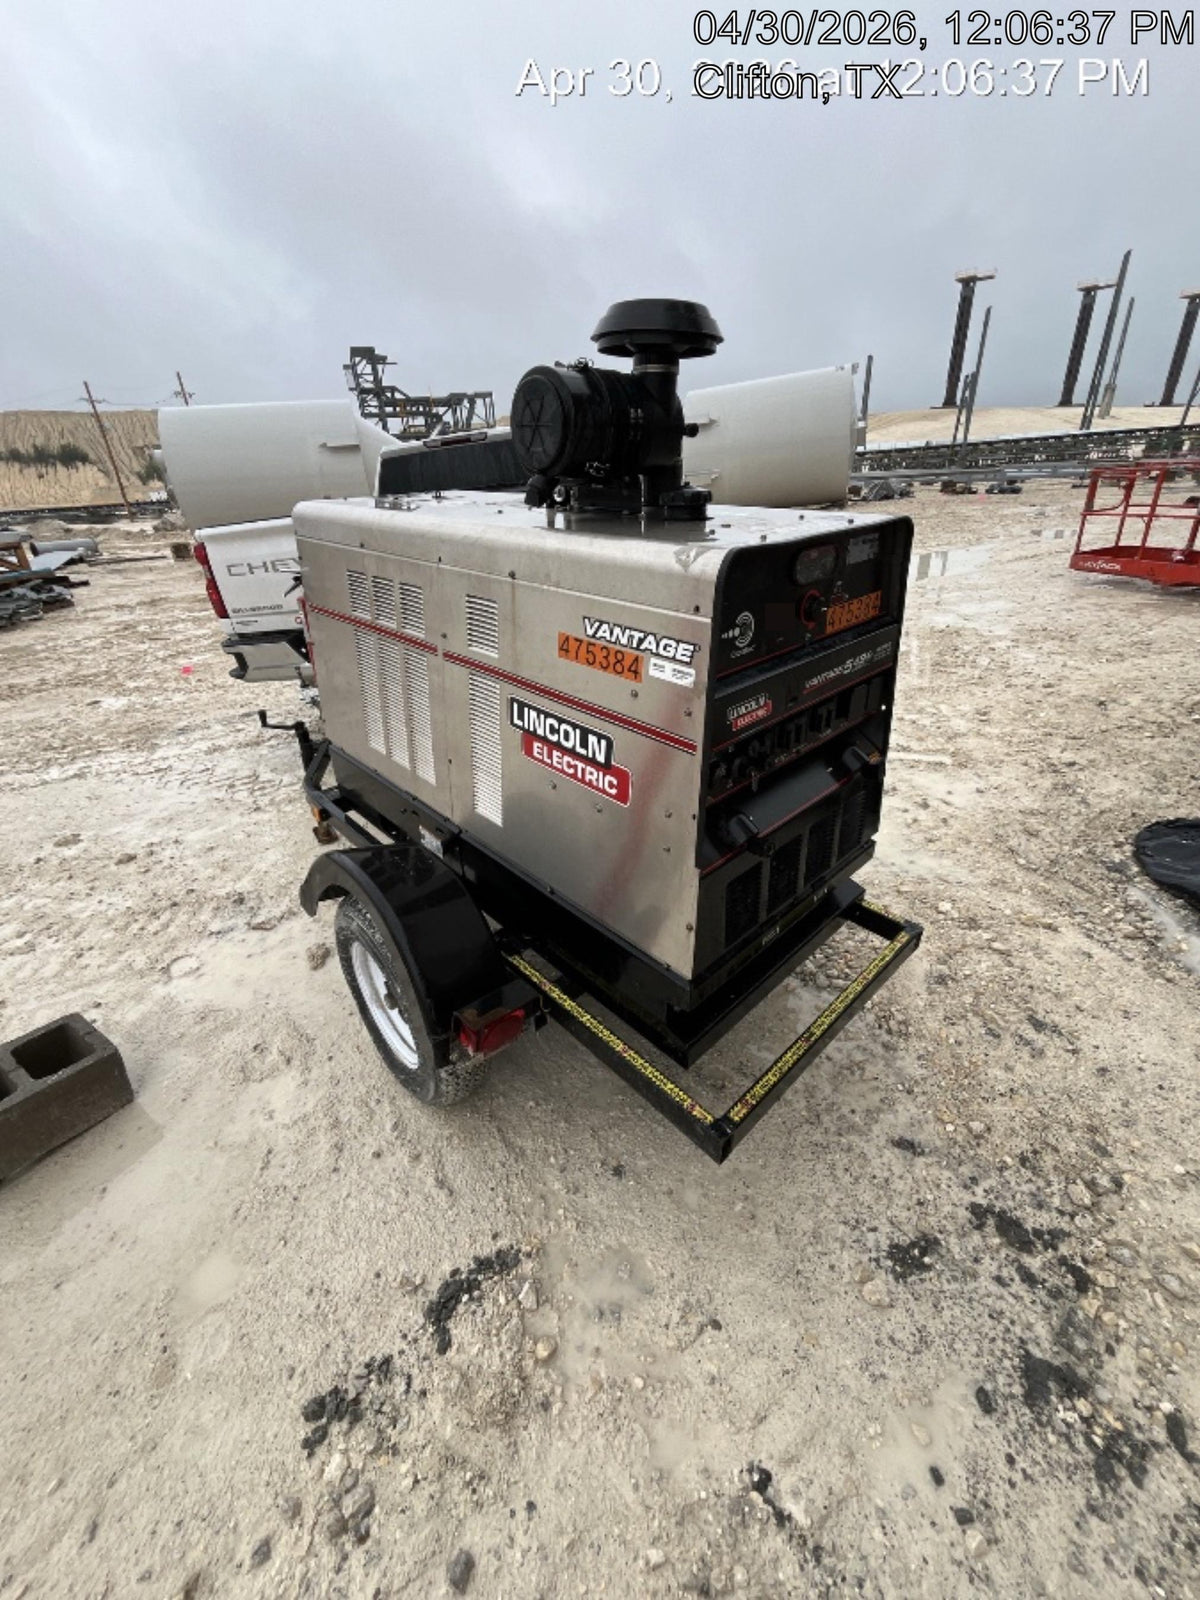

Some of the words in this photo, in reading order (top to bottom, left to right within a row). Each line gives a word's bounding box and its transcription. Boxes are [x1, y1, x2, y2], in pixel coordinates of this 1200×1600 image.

[558, 634, 641, 681] 475384
[582, 616, 697, 665] VANTAGE
[511, 700, 608, 765] LINCOLN
[531, 741, 619, 796] ELECTRIC
